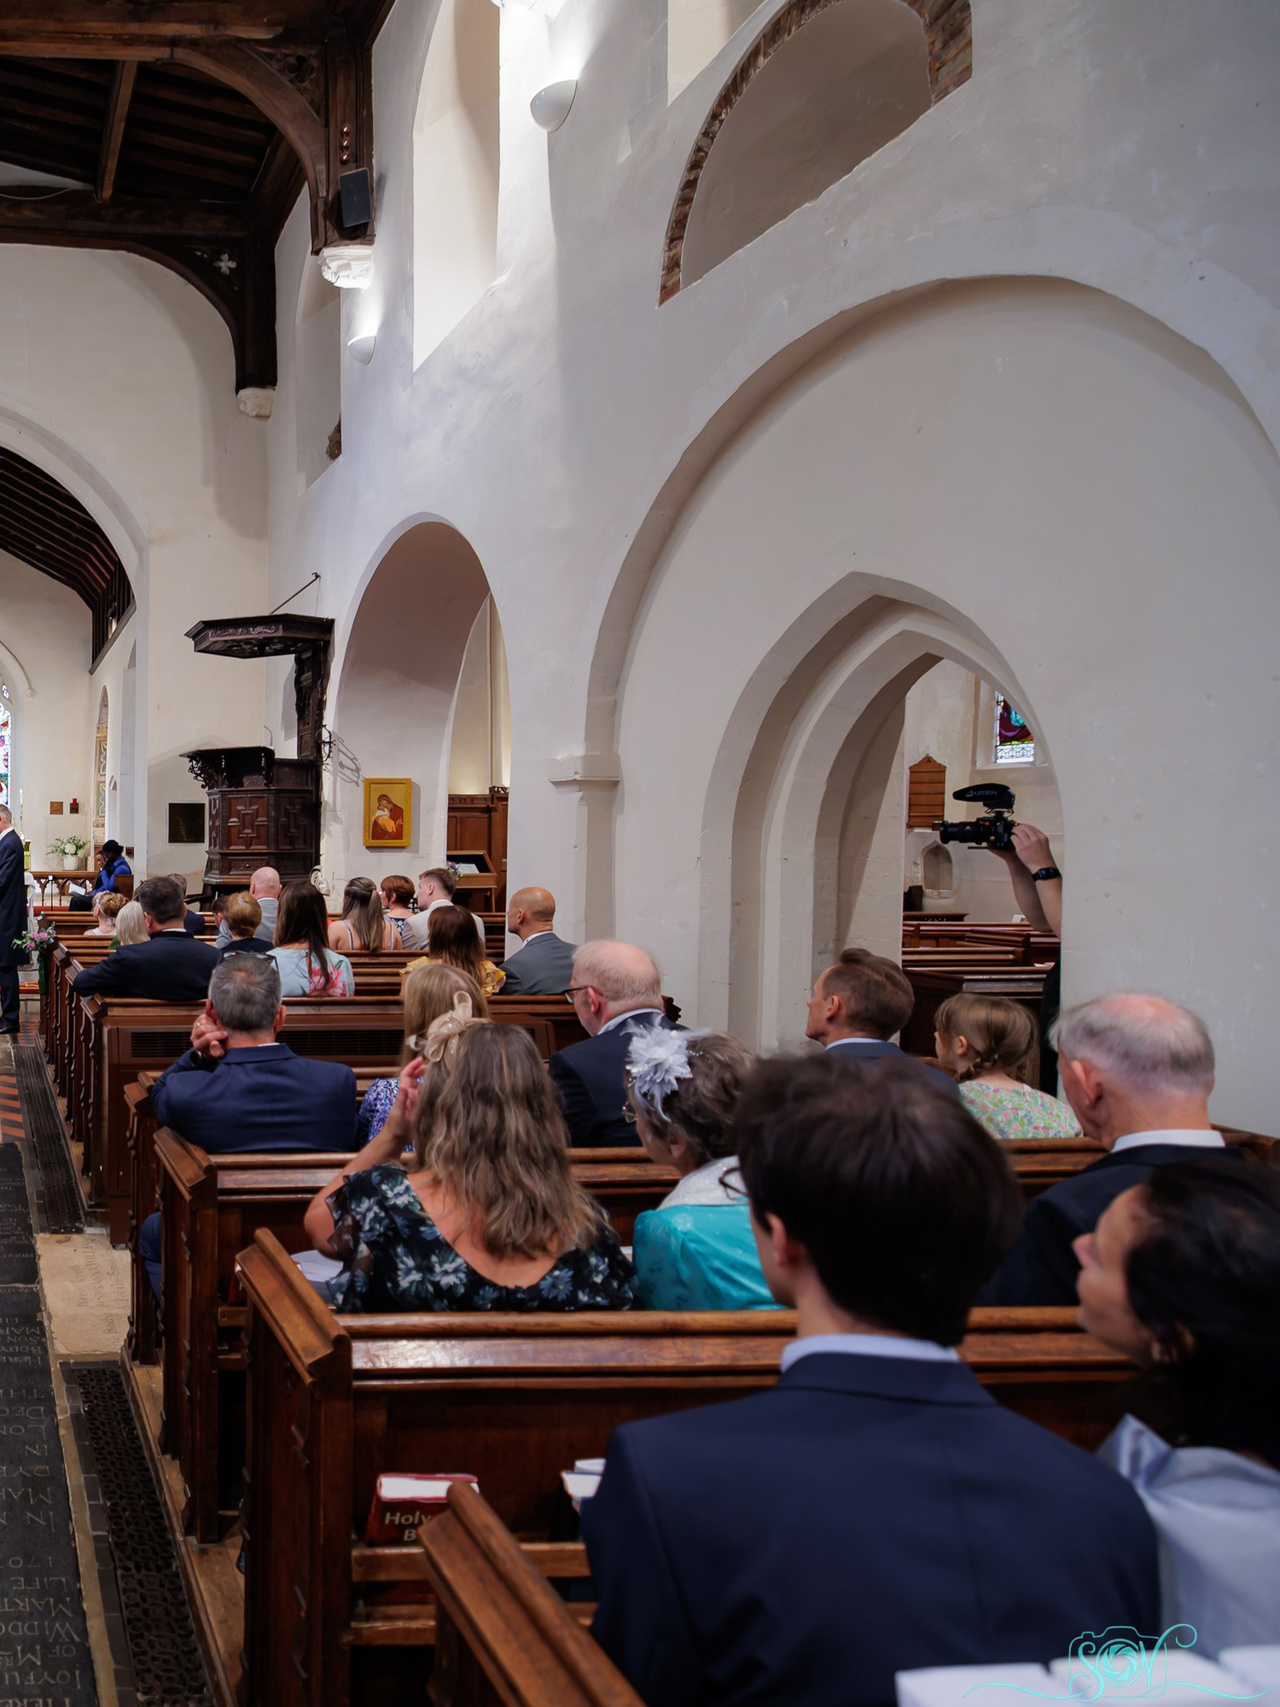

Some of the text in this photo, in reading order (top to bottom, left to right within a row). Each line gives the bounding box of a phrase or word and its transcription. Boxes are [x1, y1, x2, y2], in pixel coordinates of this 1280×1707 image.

[24, 1444, 48, 1457] IN
[26, 1511, 56, 1532] IN
[384, 1511, 431, 1526] Holy
[9, 1576, 67, 1593] LIFE
[49, 1645, 76, 1657] OF
